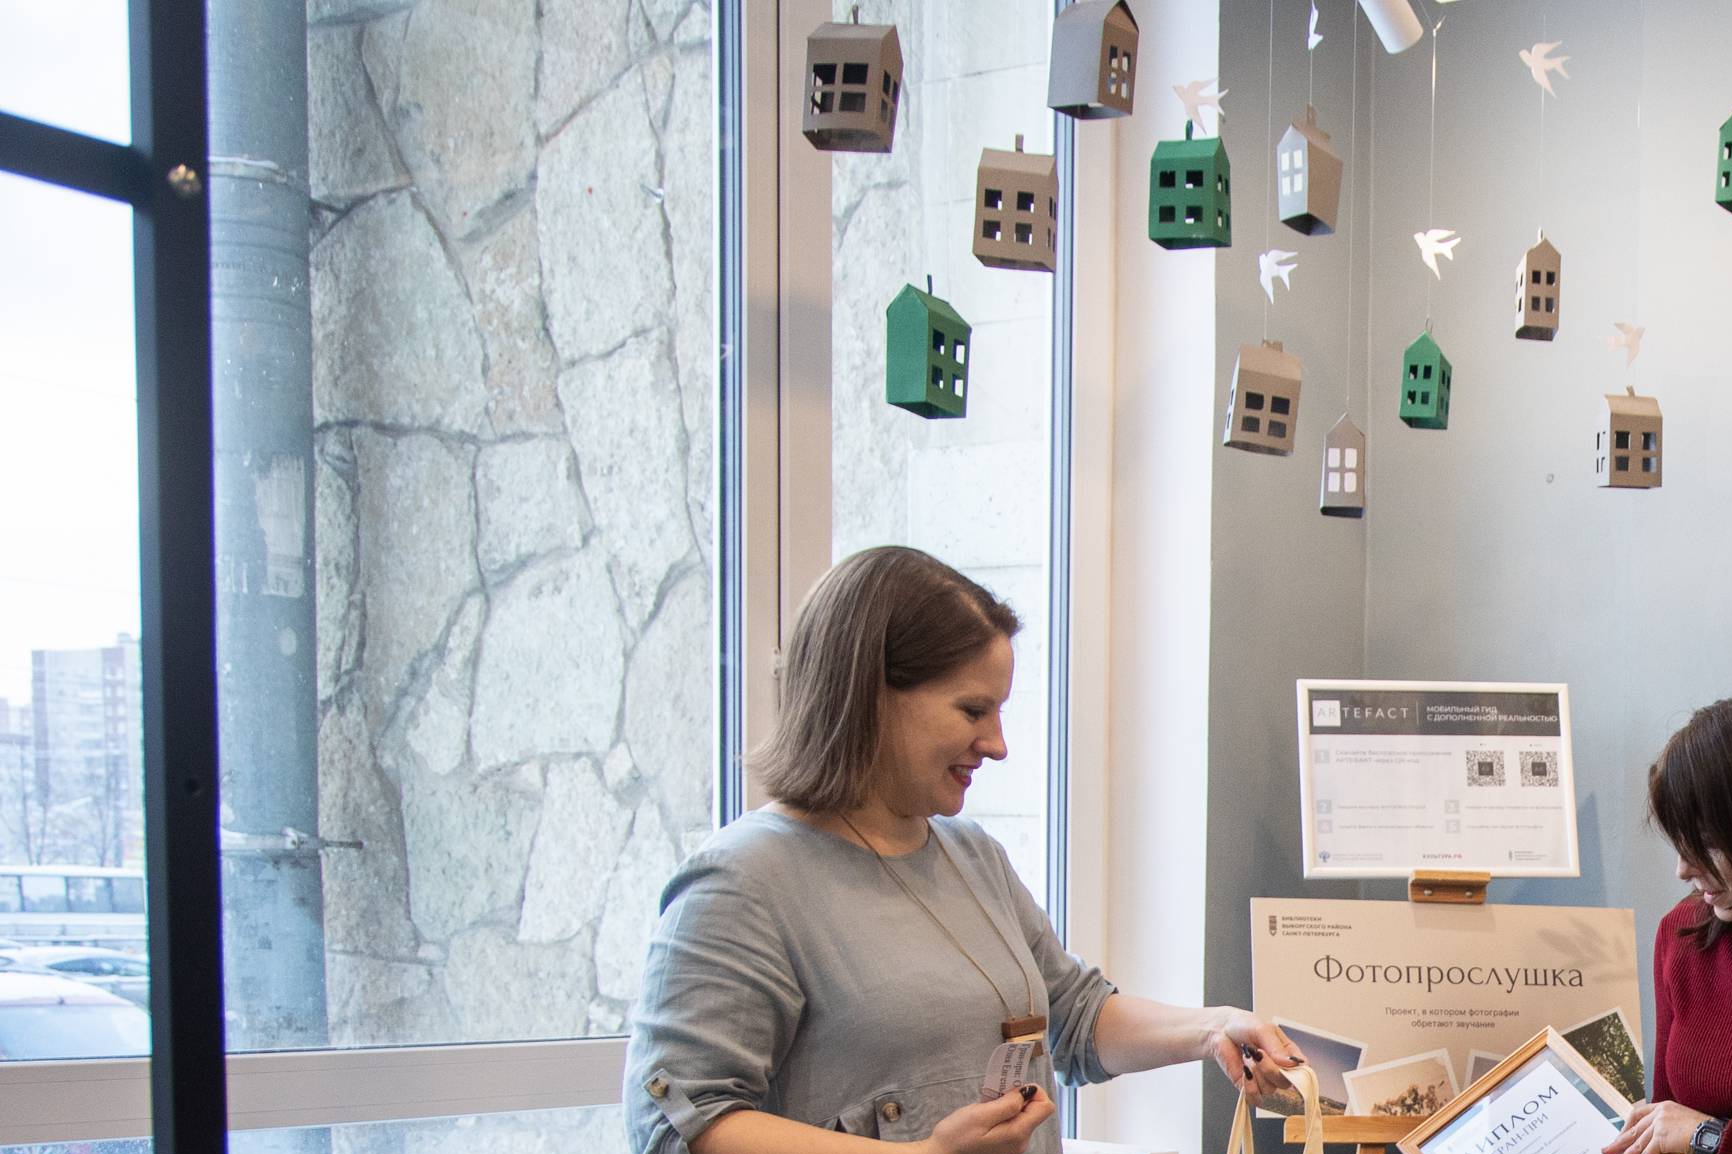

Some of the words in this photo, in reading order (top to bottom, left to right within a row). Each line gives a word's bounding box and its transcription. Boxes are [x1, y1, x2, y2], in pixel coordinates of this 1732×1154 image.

[1426, 705, 1480, 713] МОБИЛЬНЫЙ
[1481, 706, 1498, 714] ГИД
[1434, 713, 1497, 722] ДОПОЛНЕННОЙ
[1314, 955, 1583, 994] Фотопрослушка
[1385, 1007, 1420, 1017] Проект,
[1429, 1008, 1466, 1017] котором
[1468, 1008, 1520, 1018] фотографии
[1411, 1019, 1453, 1028] обретают
[1456, 1020, 1496, 1030] звучание
